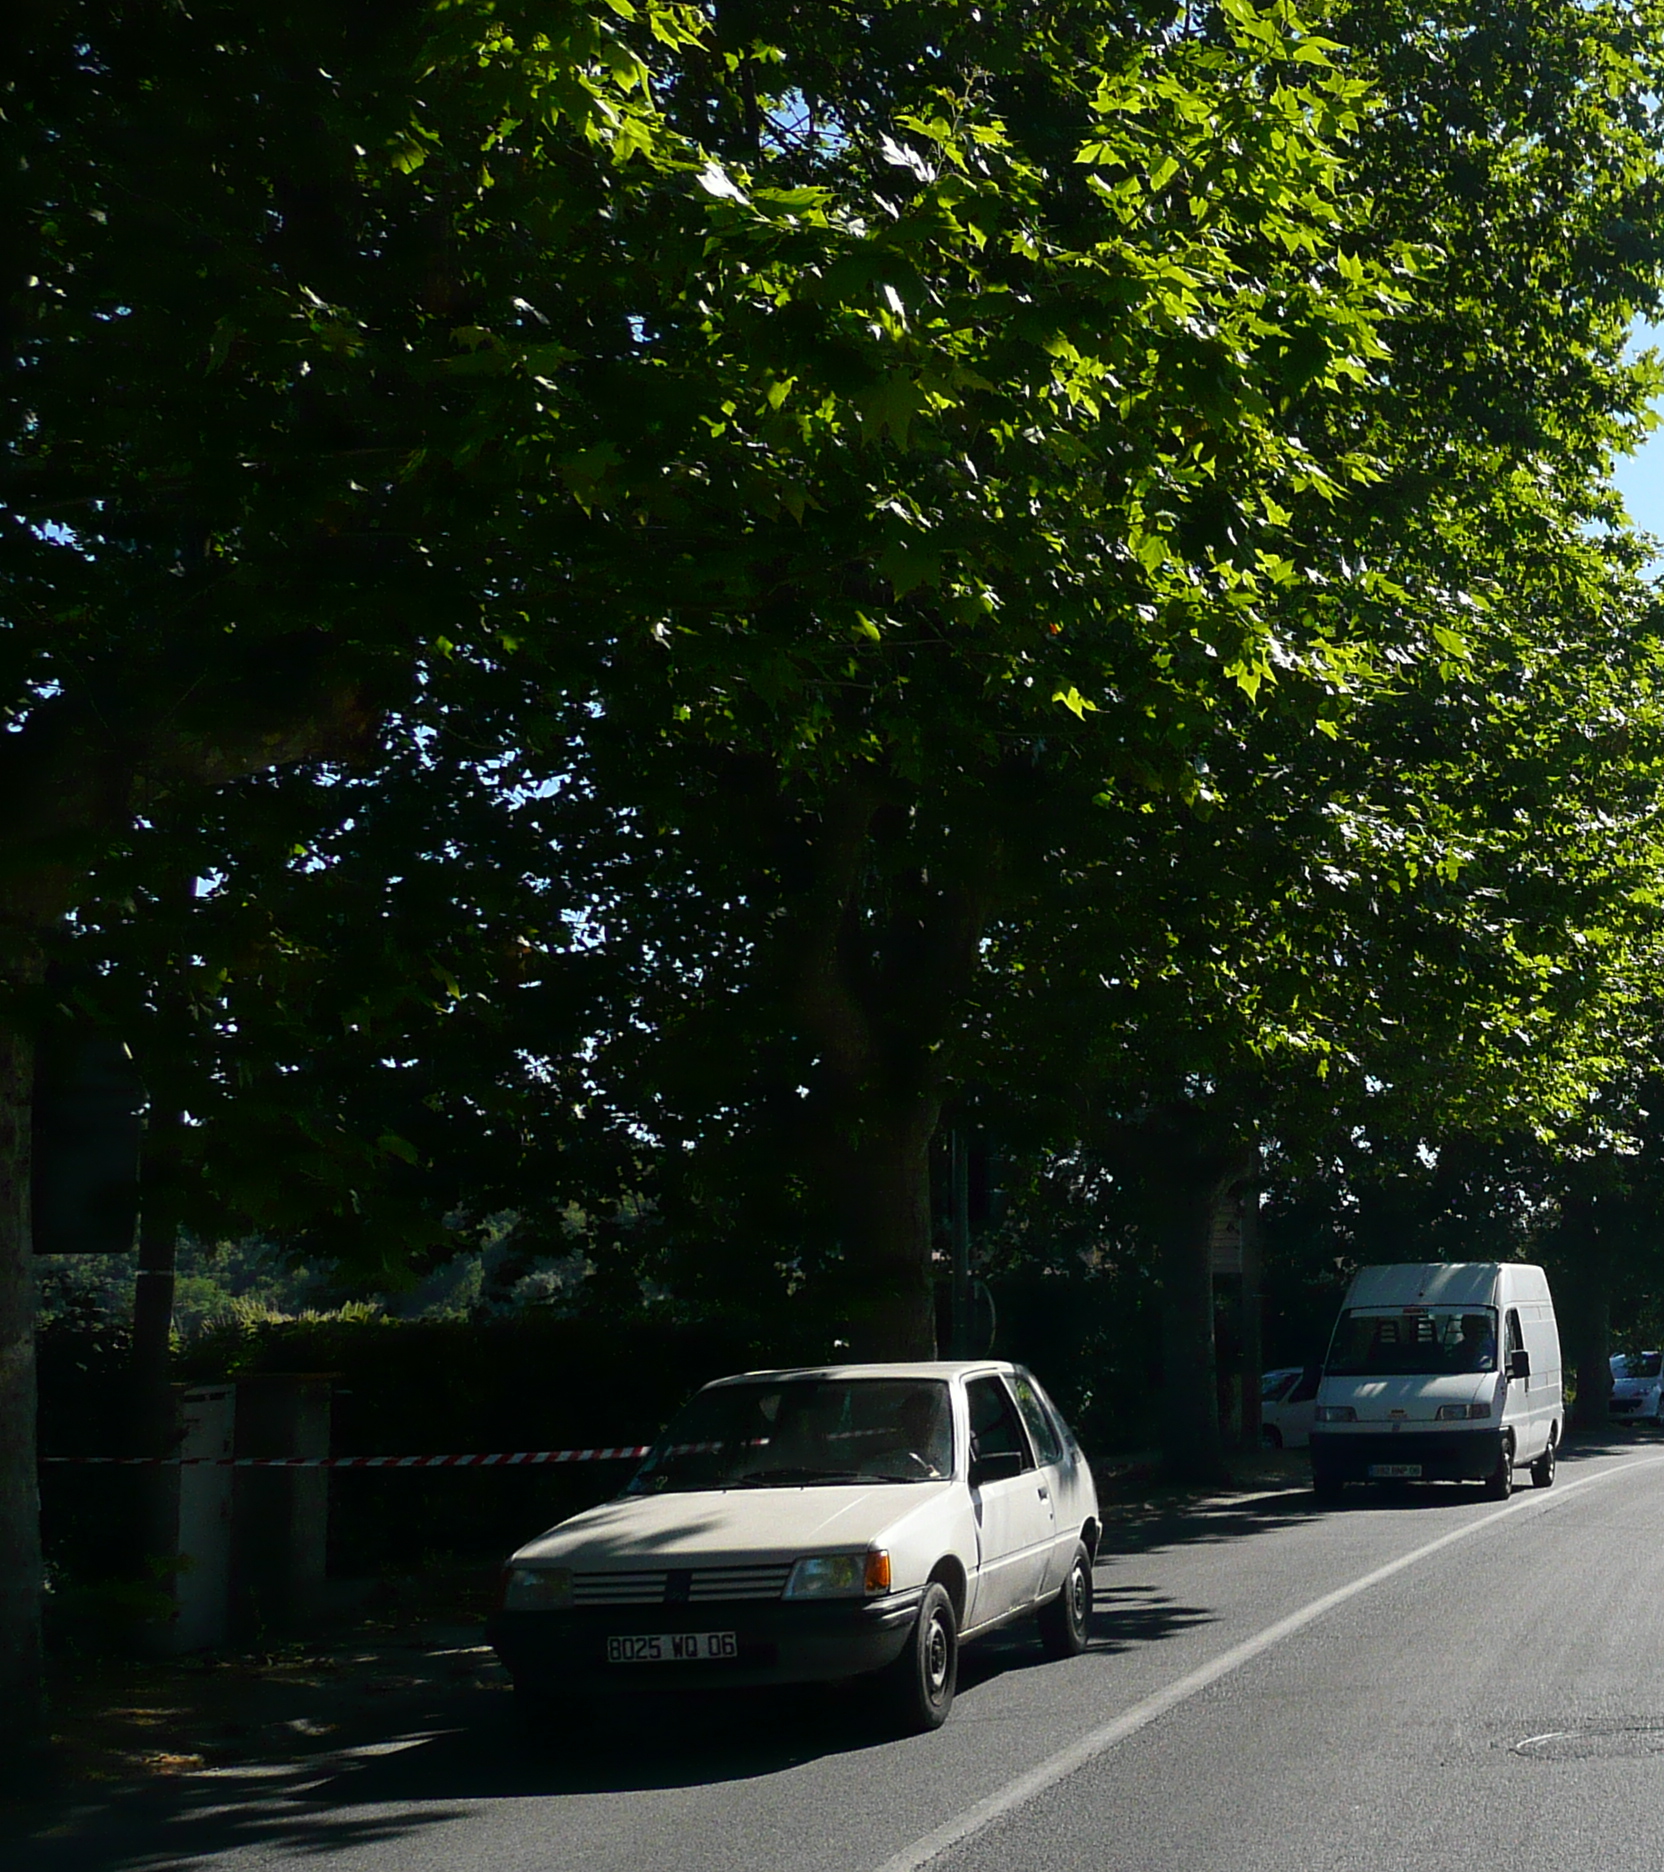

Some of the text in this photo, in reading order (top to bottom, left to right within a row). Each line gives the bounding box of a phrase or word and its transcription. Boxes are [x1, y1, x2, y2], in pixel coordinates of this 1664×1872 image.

[609, 1634, 735, 1661] 8025 WQ 06
